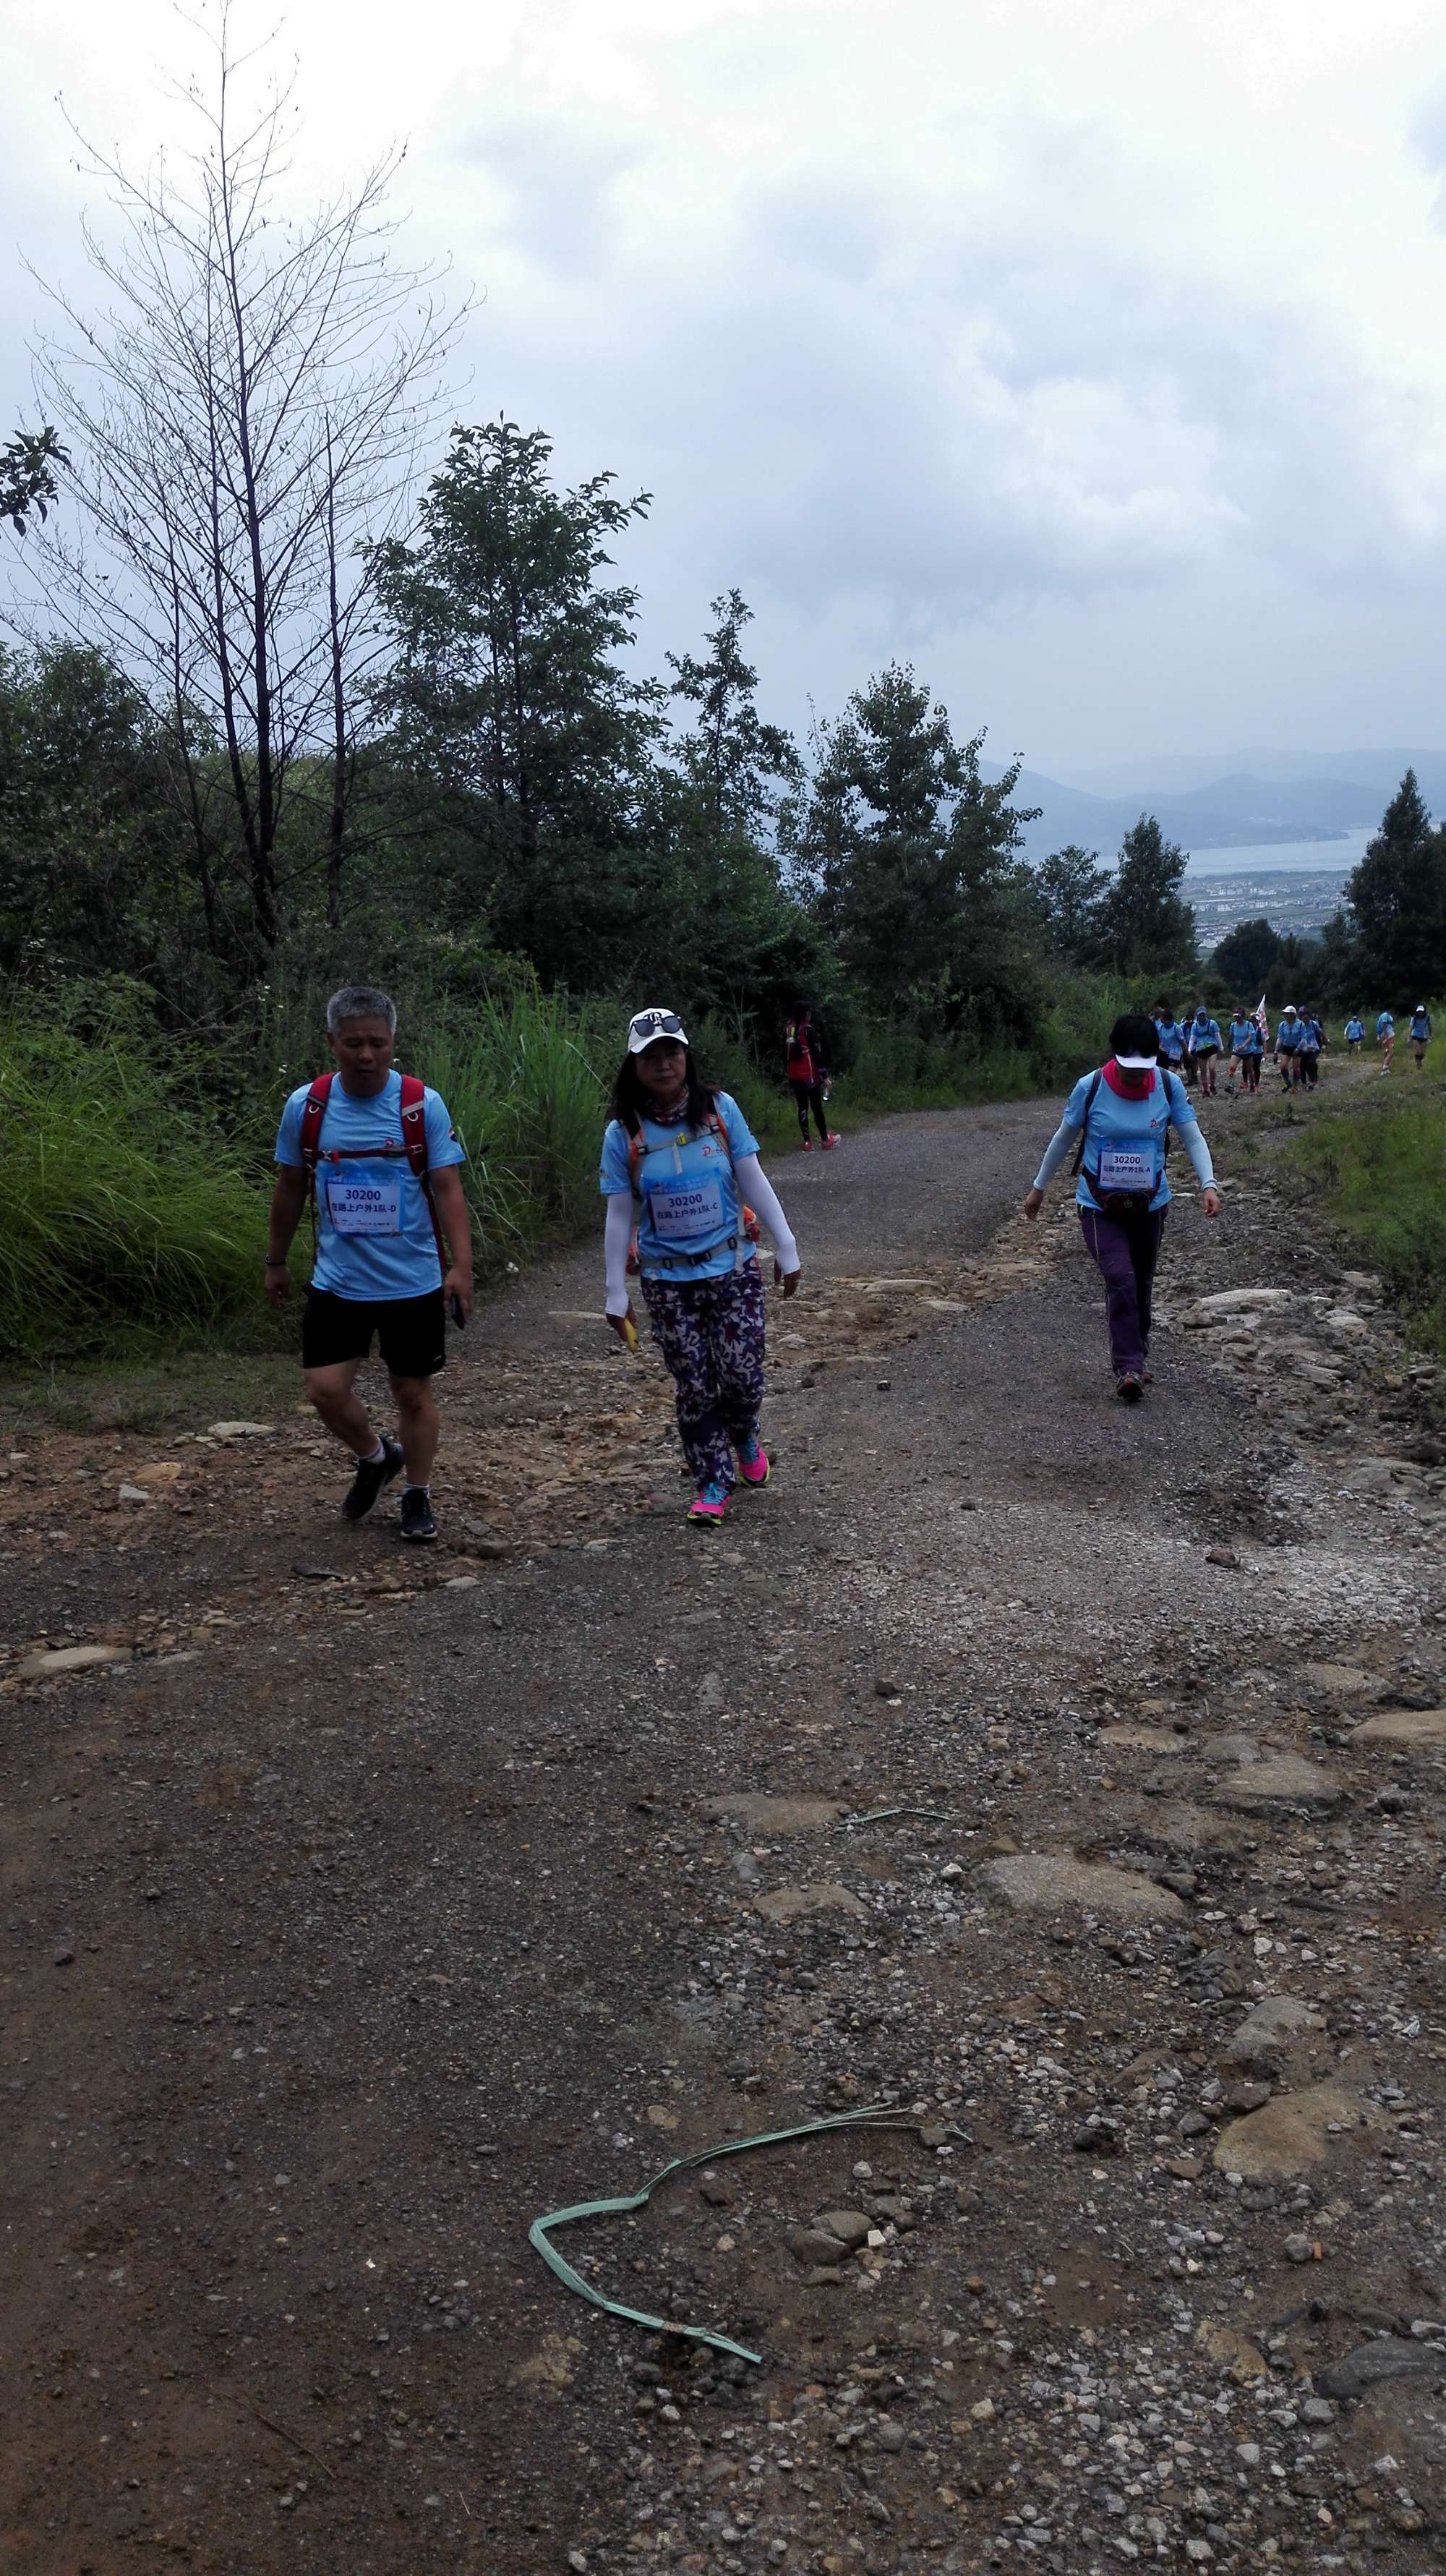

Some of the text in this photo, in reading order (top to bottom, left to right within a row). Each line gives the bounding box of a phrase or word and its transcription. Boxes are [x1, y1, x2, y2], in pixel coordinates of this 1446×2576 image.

[1114, 1156, 1140, 1164] 30200
[345, 1190, 381, 1200] 30200
[668, 1193, 702, 1207] 30200
